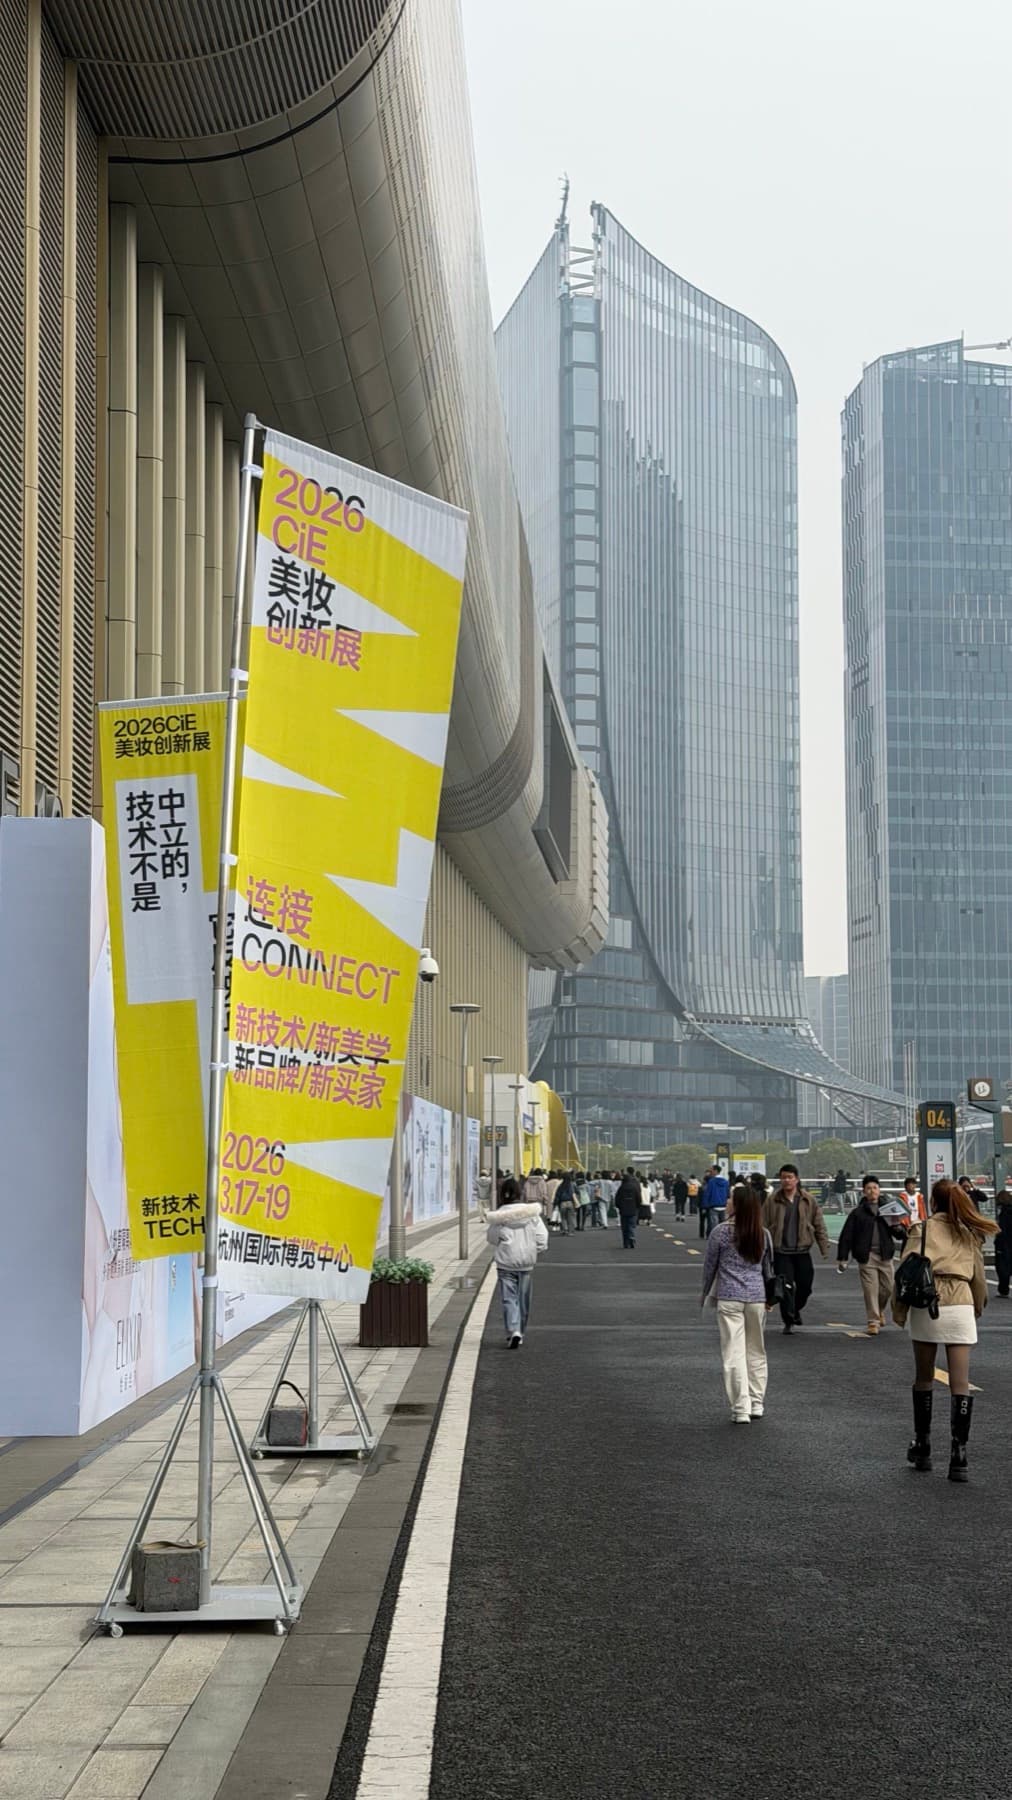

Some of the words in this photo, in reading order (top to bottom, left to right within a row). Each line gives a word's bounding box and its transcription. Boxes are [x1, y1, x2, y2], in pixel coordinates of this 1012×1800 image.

[275, 468, 366, 533] 2026
[272, 514, 328, 566] CiE
[267, 555, 336, 617] 美妆
[265, 601, 363, 672] 创新展
[114, 713, 197, 738] 2026CiE
[115, 731, 212, 759] 美妆创新展
[126, 790, 162, 913] 技术不是
[244, 875, 314, 940] 连接
[241, 932, 400, 1005] CONNECT
[235, 1002, 392, 1071] 新技术/新美学
[233, 1043, 387, 1110] 新品牌/新买家
[927, 1110, 946, 1128] 04
[222, 1131, 286, 1177] 2026
[142, 1193, 201, 1217] 新技术
[220, 1175, 290, 1220] 3.17-19
